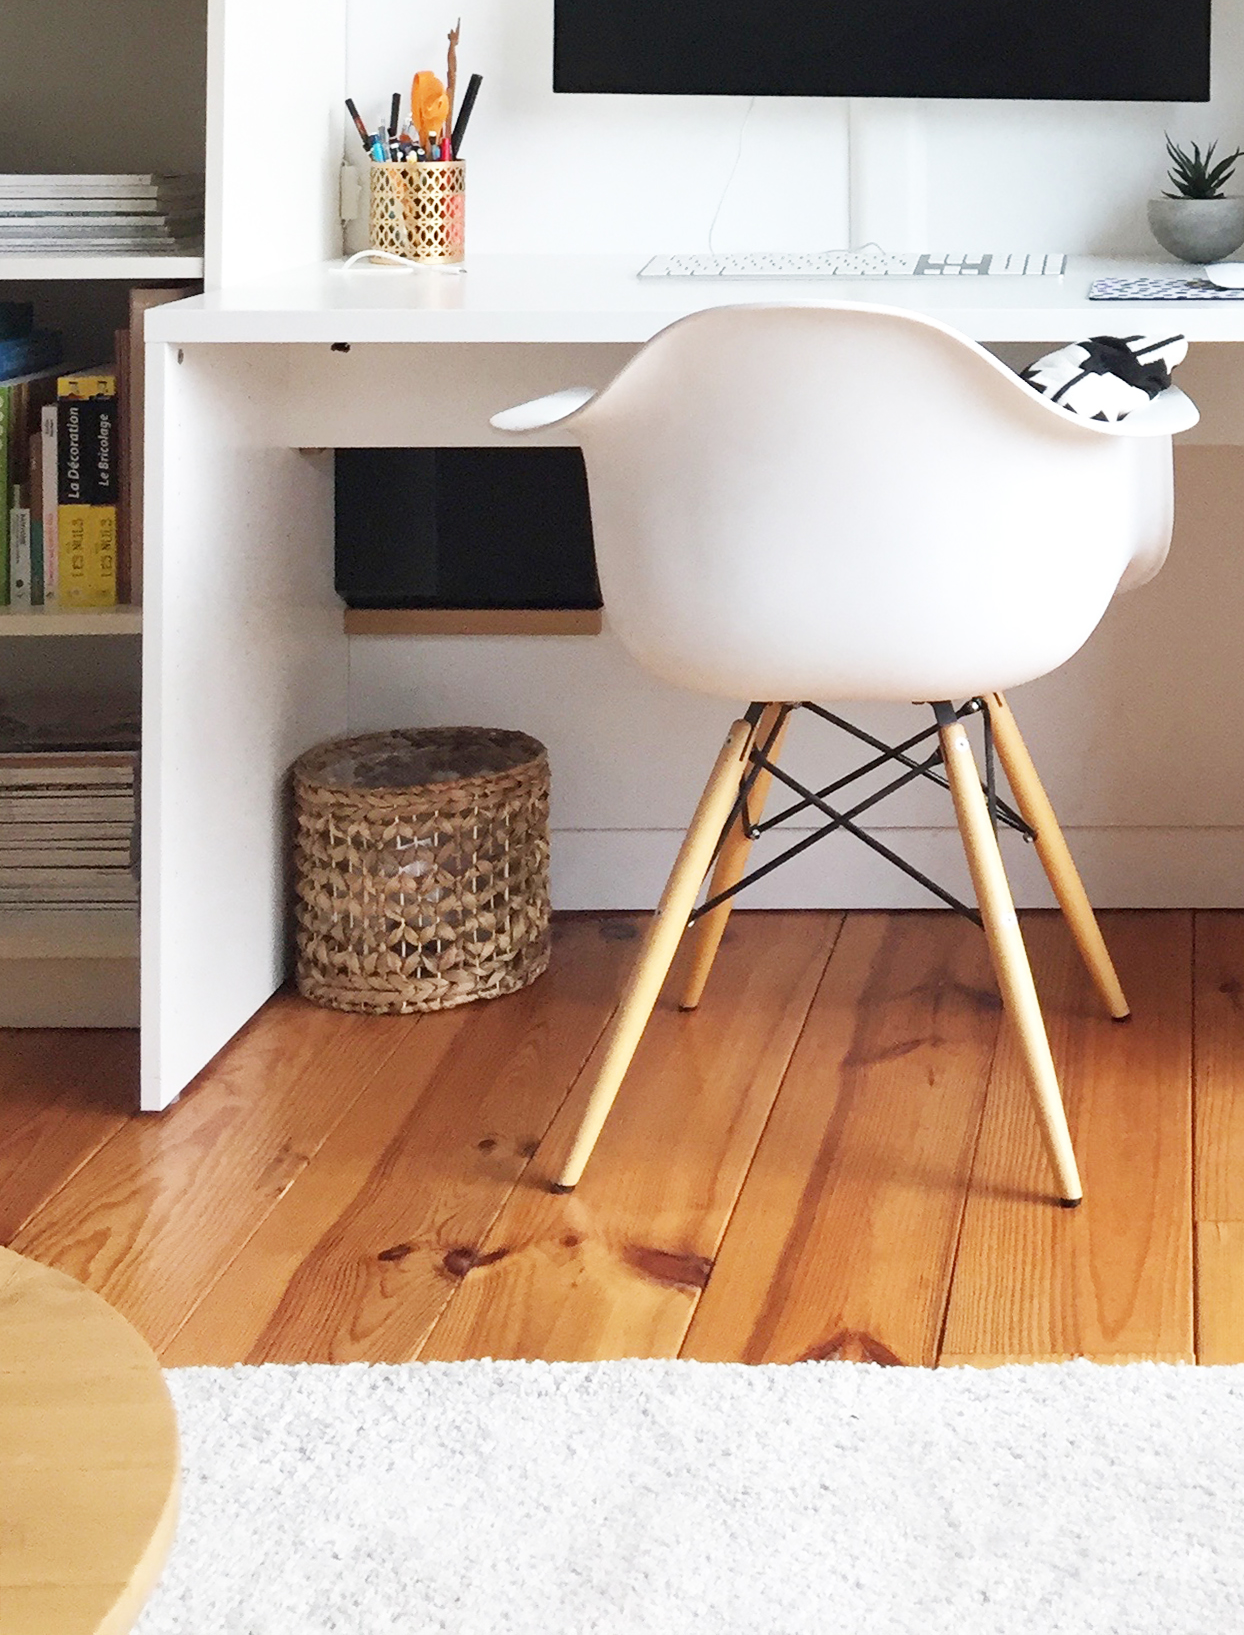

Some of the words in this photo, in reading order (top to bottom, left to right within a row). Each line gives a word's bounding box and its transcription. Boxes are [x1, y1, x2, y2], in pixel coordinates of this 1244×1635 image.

[66, 407, 81, 479] Décoration
[98, 413, 112, 470] Bricolage
[67, 482, 81, 499] La
[98, 472, 109, 486] Le
